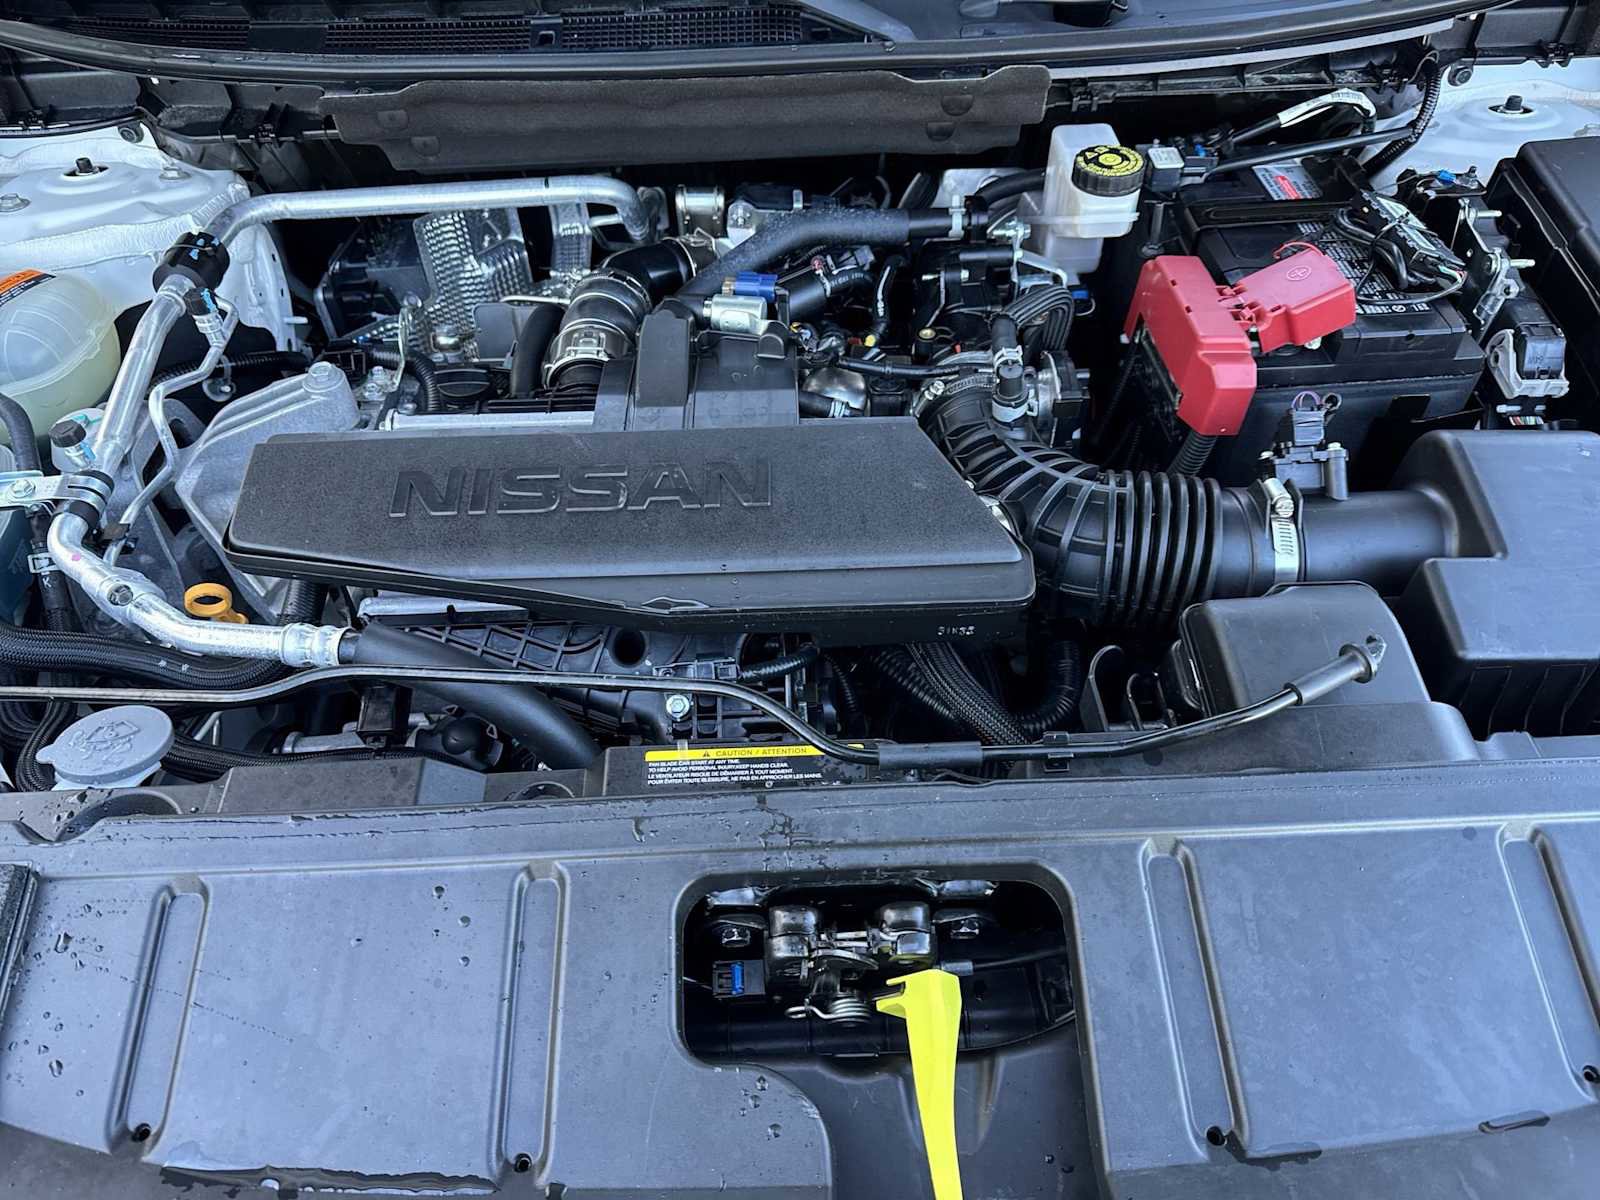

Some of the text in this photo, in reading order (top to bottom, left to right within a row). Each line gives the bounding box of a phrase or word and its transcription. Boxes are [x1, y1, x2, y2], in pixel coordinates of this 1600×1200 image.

[389, 462, 771, 517] NISSAN
[715, 749, 753, 757] CAUTION
[762, 747, 807, 755] ATTENTION
